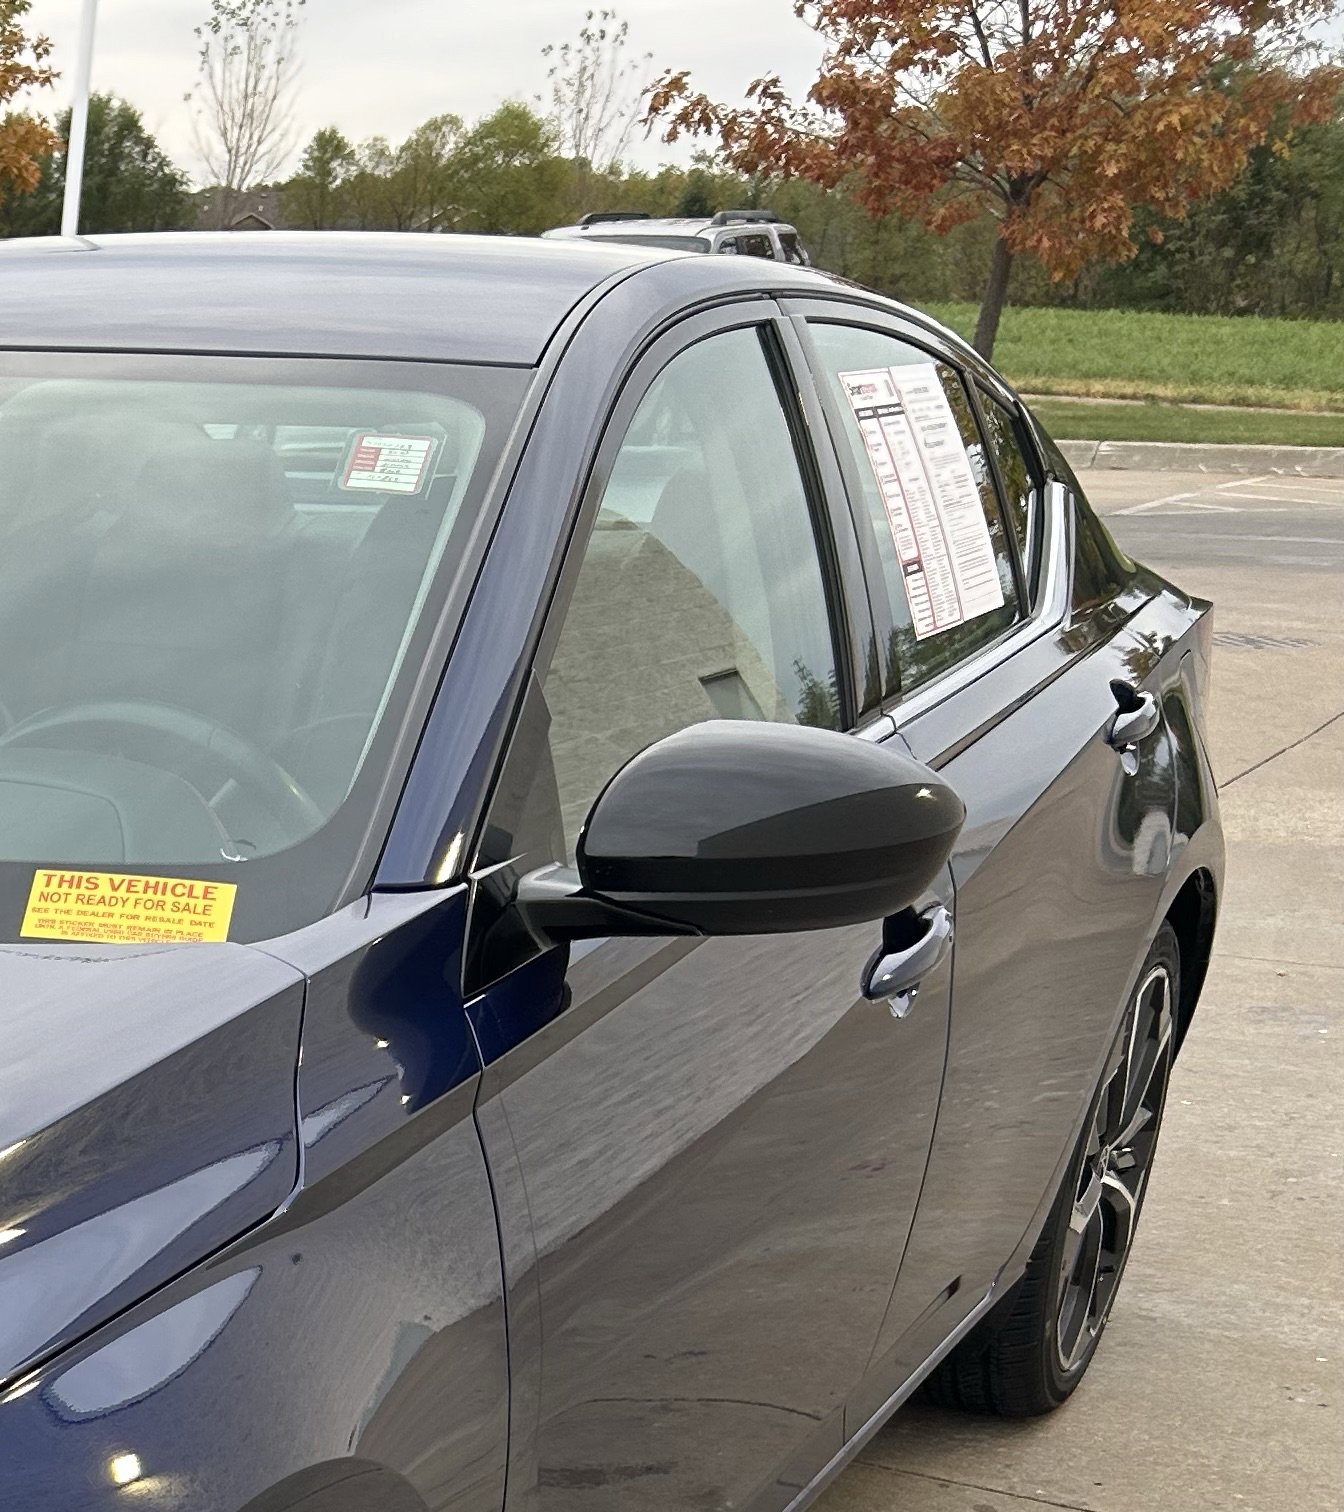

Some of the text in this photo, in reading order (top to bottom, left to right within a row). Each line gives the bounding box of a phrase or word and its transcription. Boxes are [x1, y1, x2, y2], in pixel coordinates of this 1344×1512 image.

[43, 873, 219, 901] THIS VEHICLE
[39, 891, 213, 916] NOT READY FOR SALE
[31, 907, 216, 929] SEE THE DEALER FOR RESALE DATE
